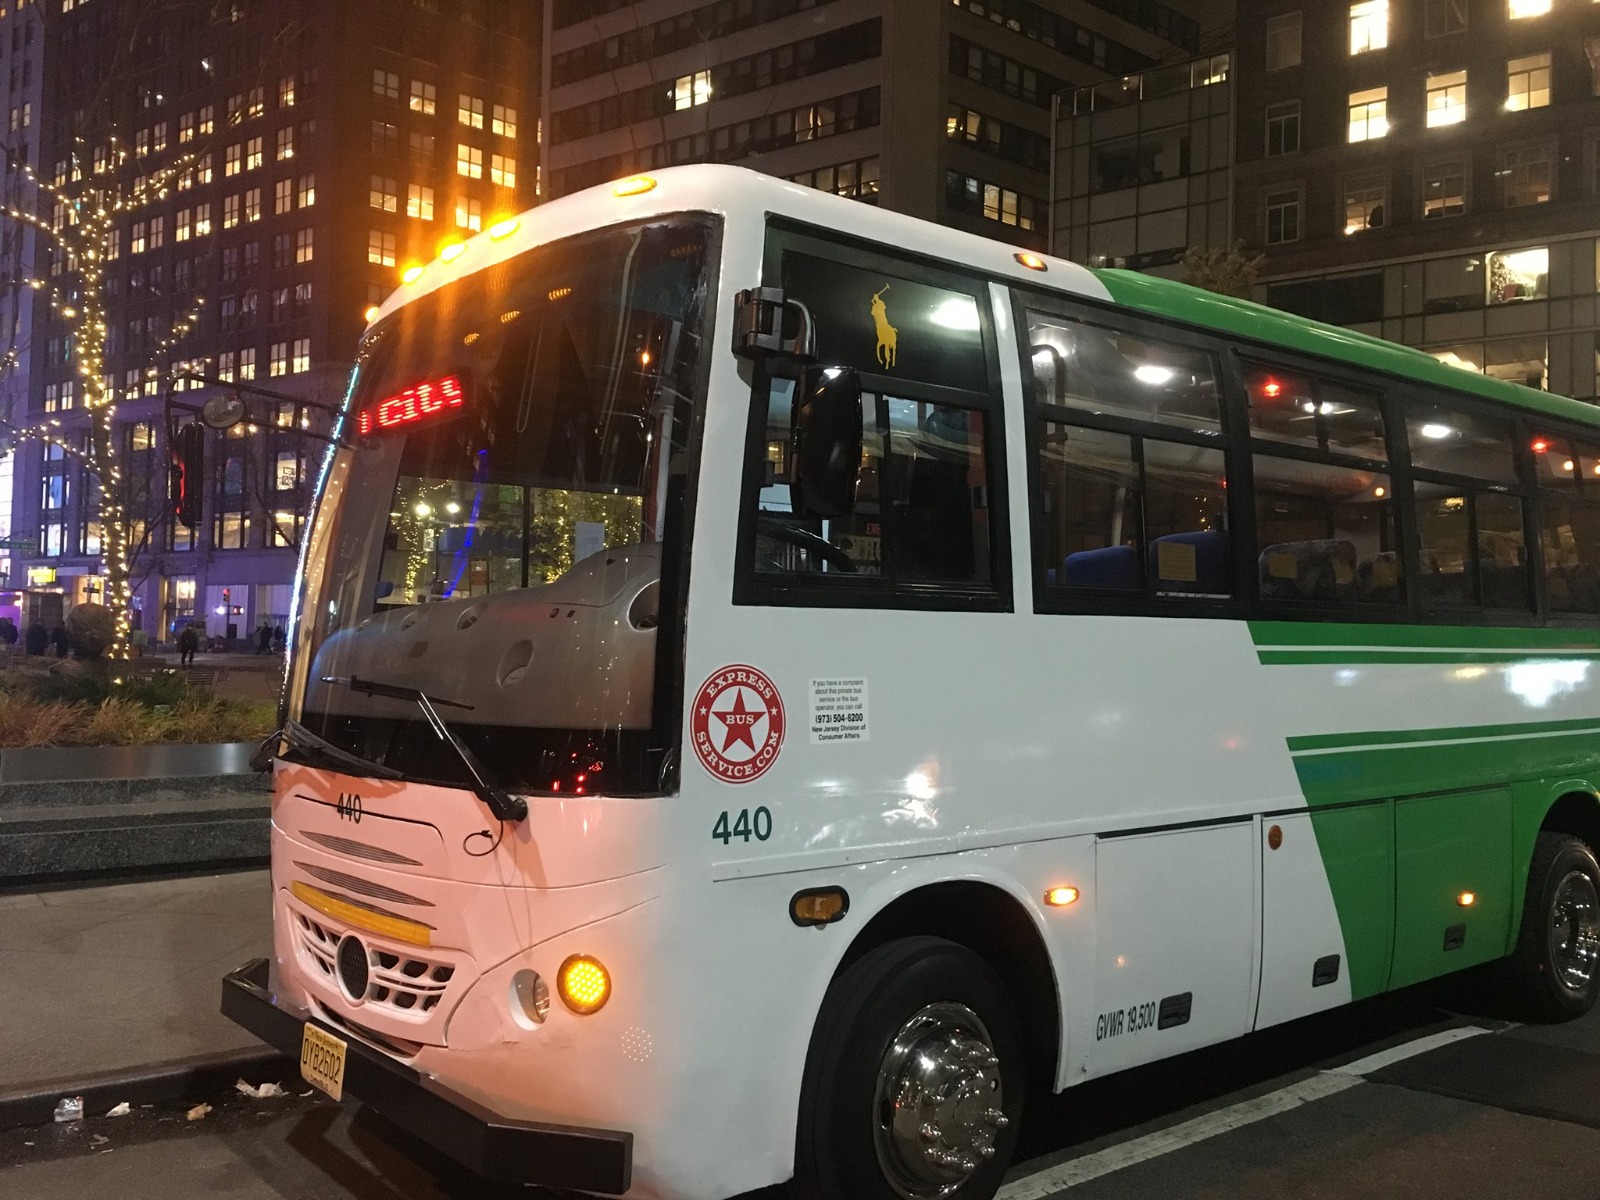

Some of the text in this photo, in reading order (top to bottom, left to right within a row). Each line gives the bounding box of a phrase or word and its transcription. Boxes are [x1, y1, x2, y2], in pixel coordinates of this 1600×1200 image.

[705, 671, 773, 699] EXPRESS
[725, 714, 755, 725] BUS
[815, 712, 864, 724] (973) 504-6200
[696, 730, 780, 776] SERVICE.COM
[336, 792, 362, 824] 440
[712, 806, 772, 845] 440
[1096, 1001, 1156, 1042] GVWR 19,500
